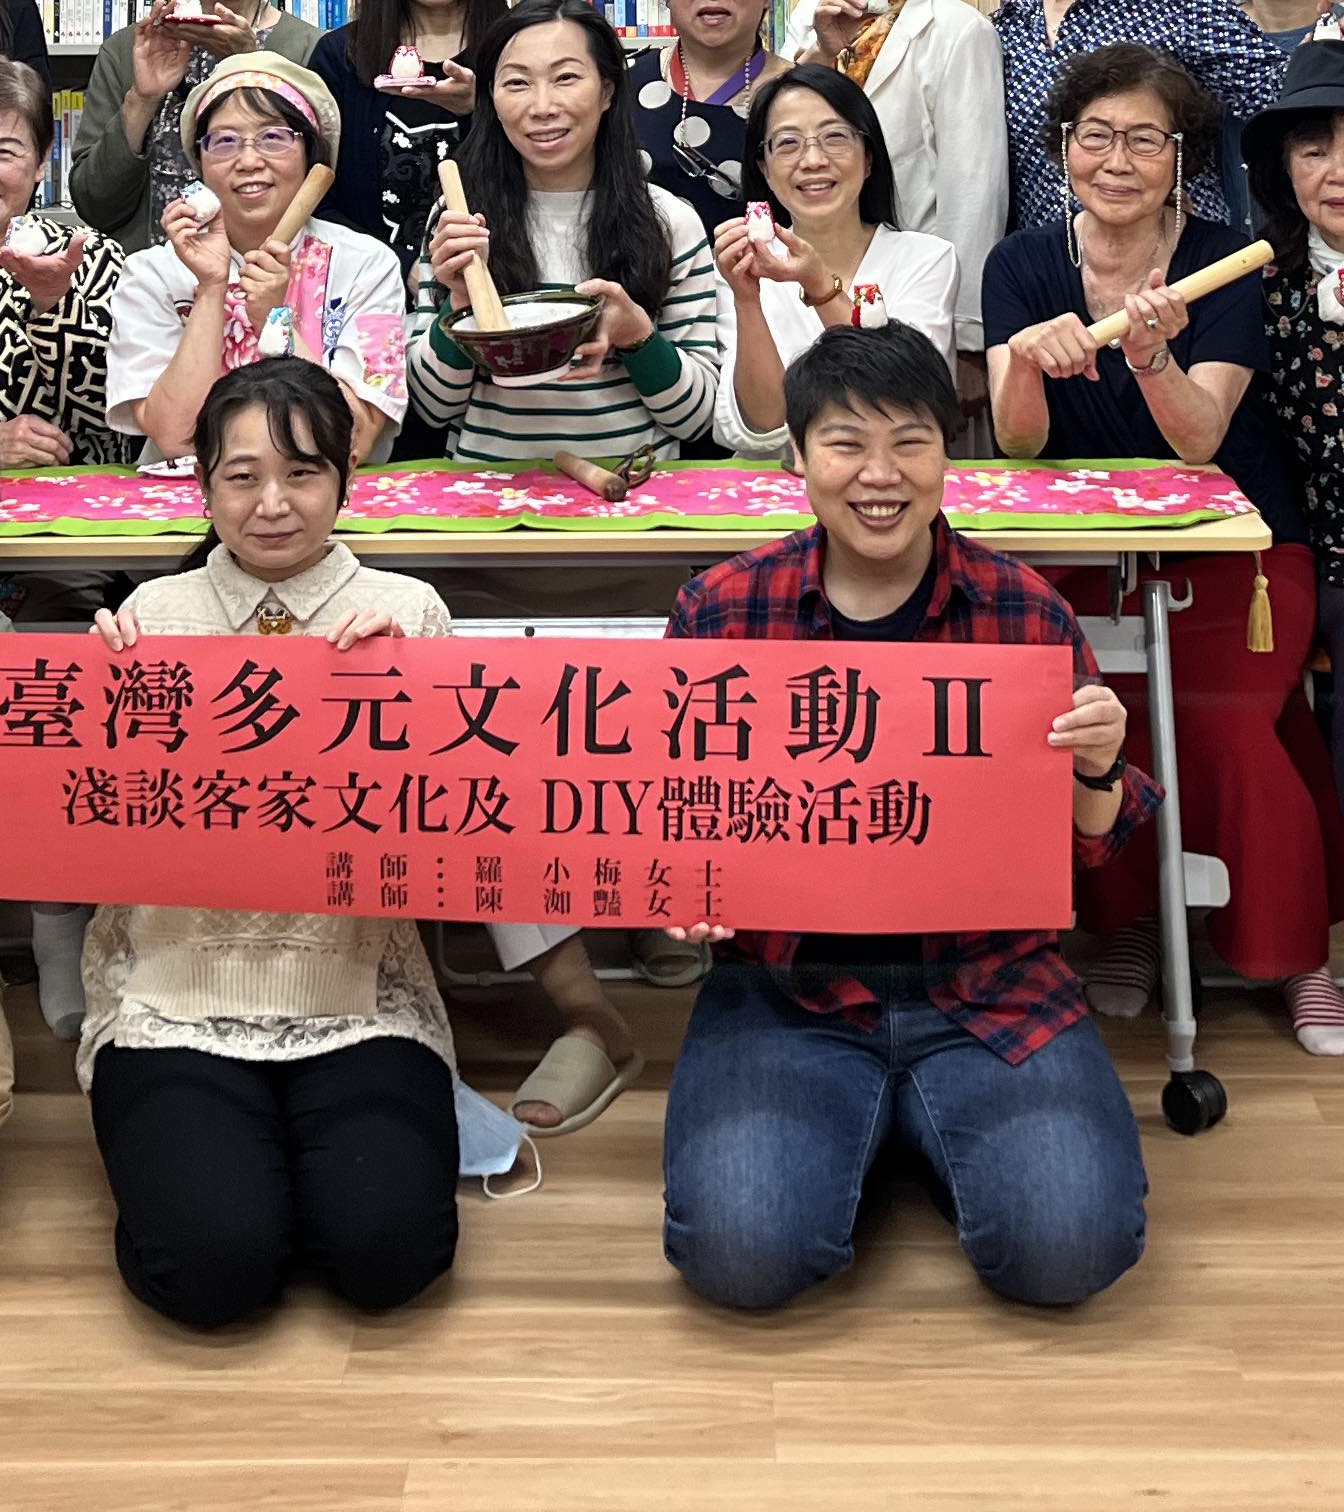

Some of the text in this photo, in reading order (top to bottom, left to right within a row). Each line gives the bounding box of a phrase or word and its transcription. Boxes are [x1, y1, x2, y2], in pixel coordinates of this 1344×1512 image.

[61, 767, 933, 846] 淺談客家文化及 DIY體驗活動
